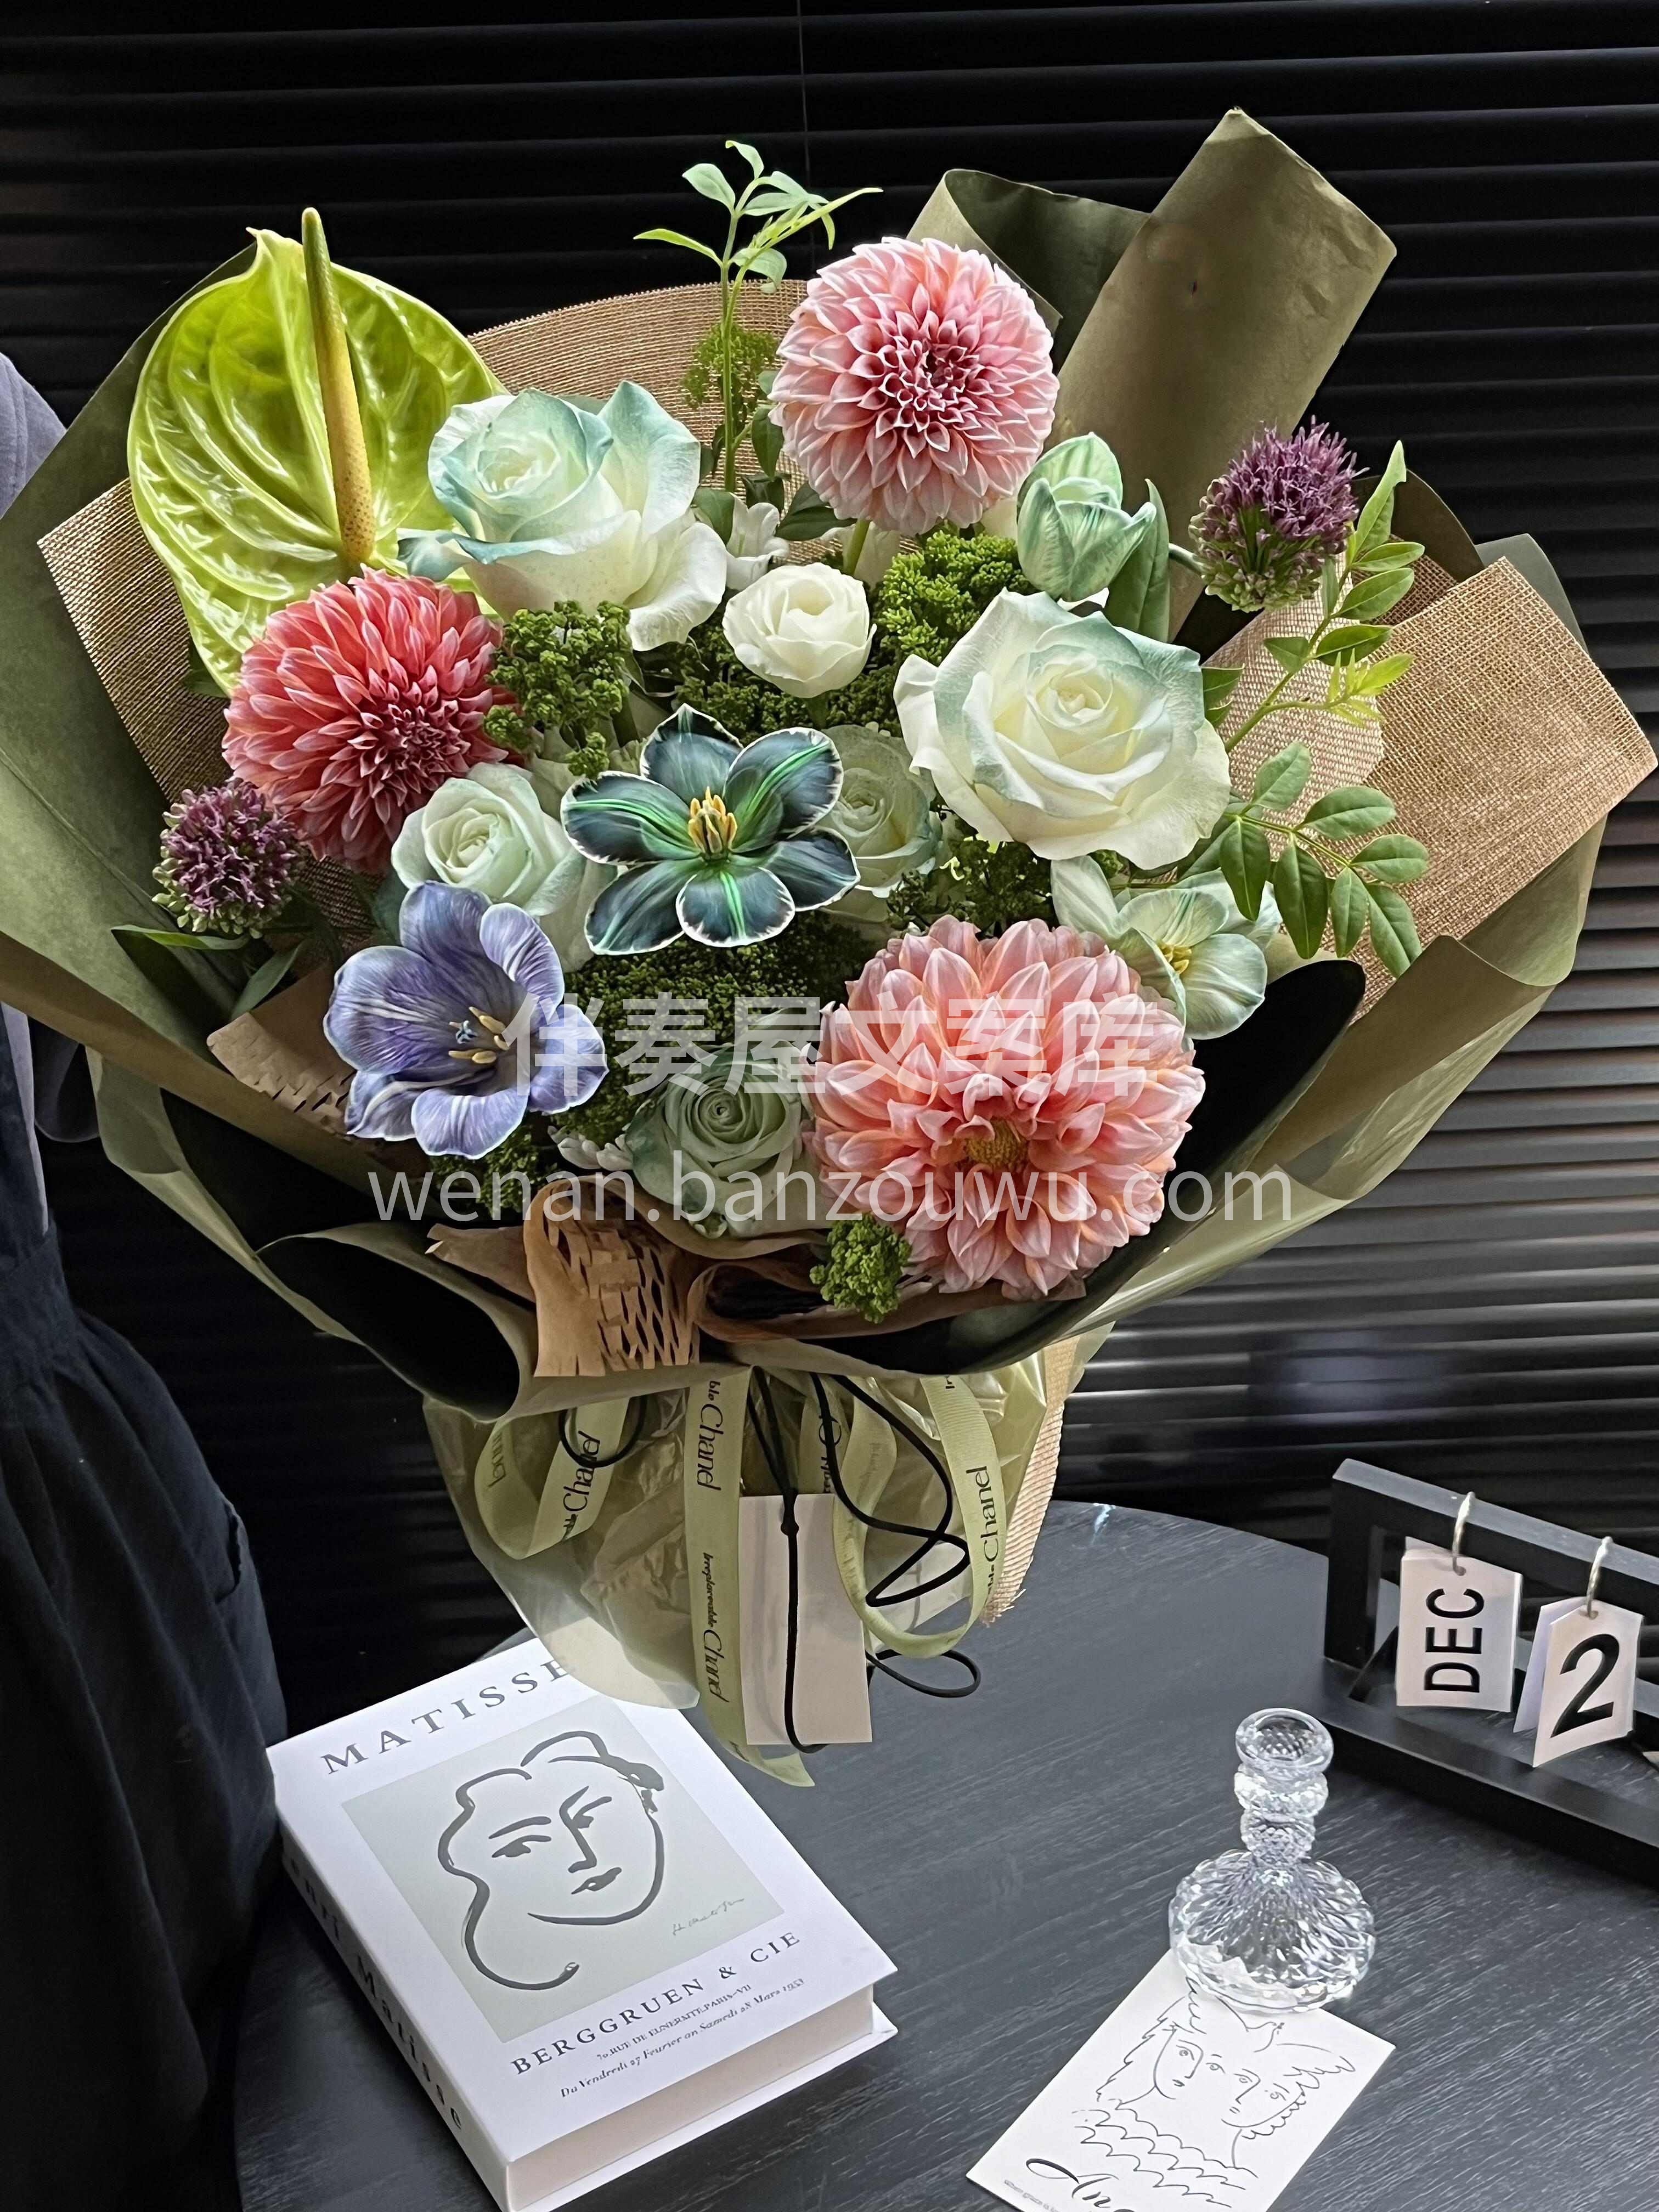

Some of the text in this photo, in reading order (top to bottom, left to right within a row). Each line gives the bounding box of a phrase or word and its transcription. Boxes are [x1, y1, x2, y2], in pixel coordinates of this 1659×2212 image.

[697, 1403, 724, 1491] Chanel
[966, 1466, 999, 1562] Chanel
[1424, 1588, 1485, 1692] DEC
[1550, 1633, 1620, 1739] 2
[320, 1660, 569, 1774] MATISSE
[510, 1932, 800, 2074] BERGGRUEN & CIE
